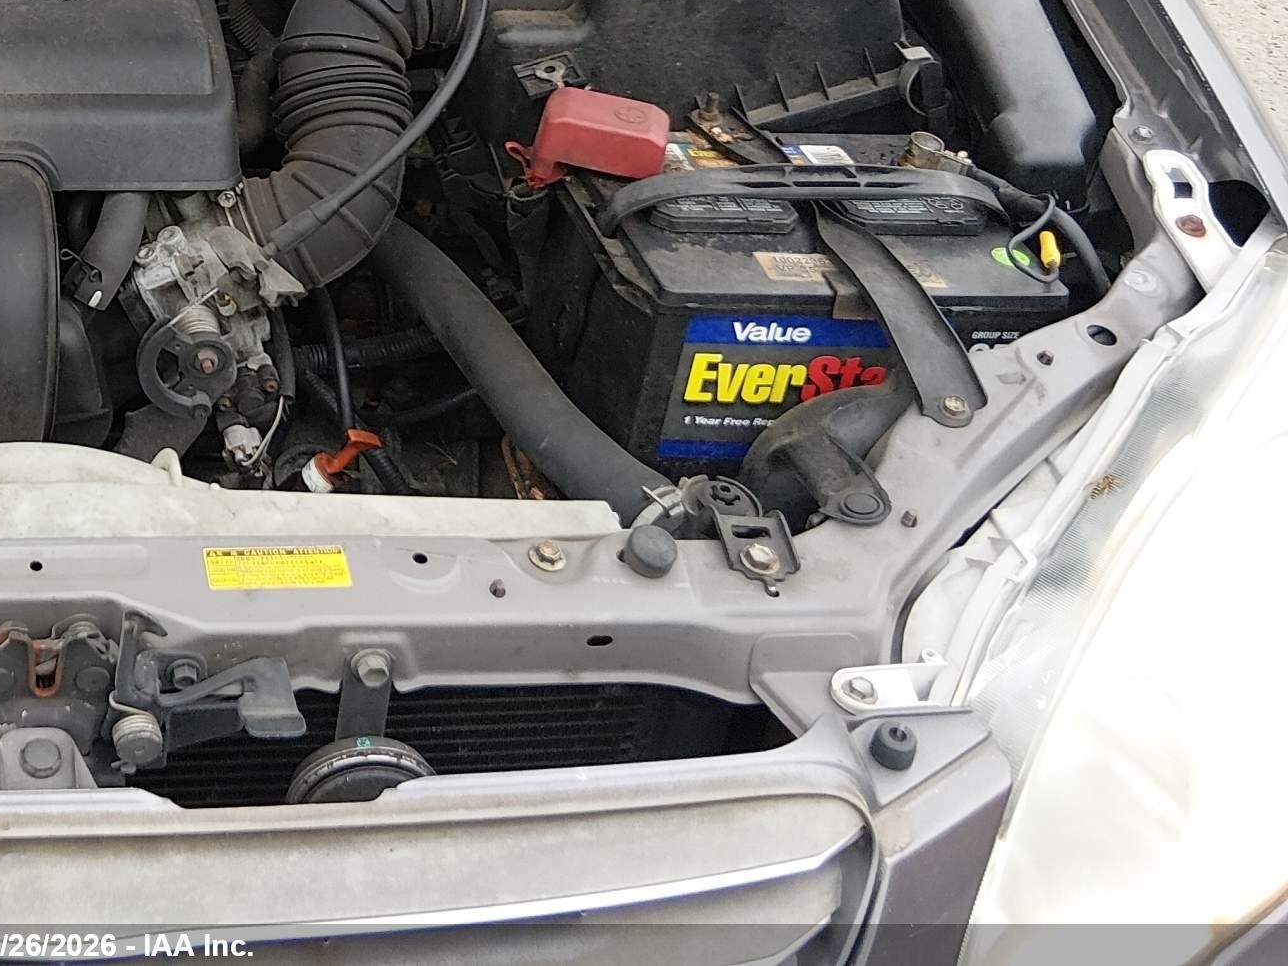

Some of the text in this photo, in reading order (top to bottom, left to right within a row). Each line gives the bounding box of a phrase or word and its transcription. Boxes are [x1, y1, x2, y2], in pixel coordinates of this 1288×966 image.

[732, 321, 812, 343] Value
[972, 331, 1020, 340] GROUP SIZE
[684, 416, 691, 425] 1
[695, 416, 721, 426] Year
[723, 417, 750, 426] Free
[293, 547, 340, 555] ATTENTION
